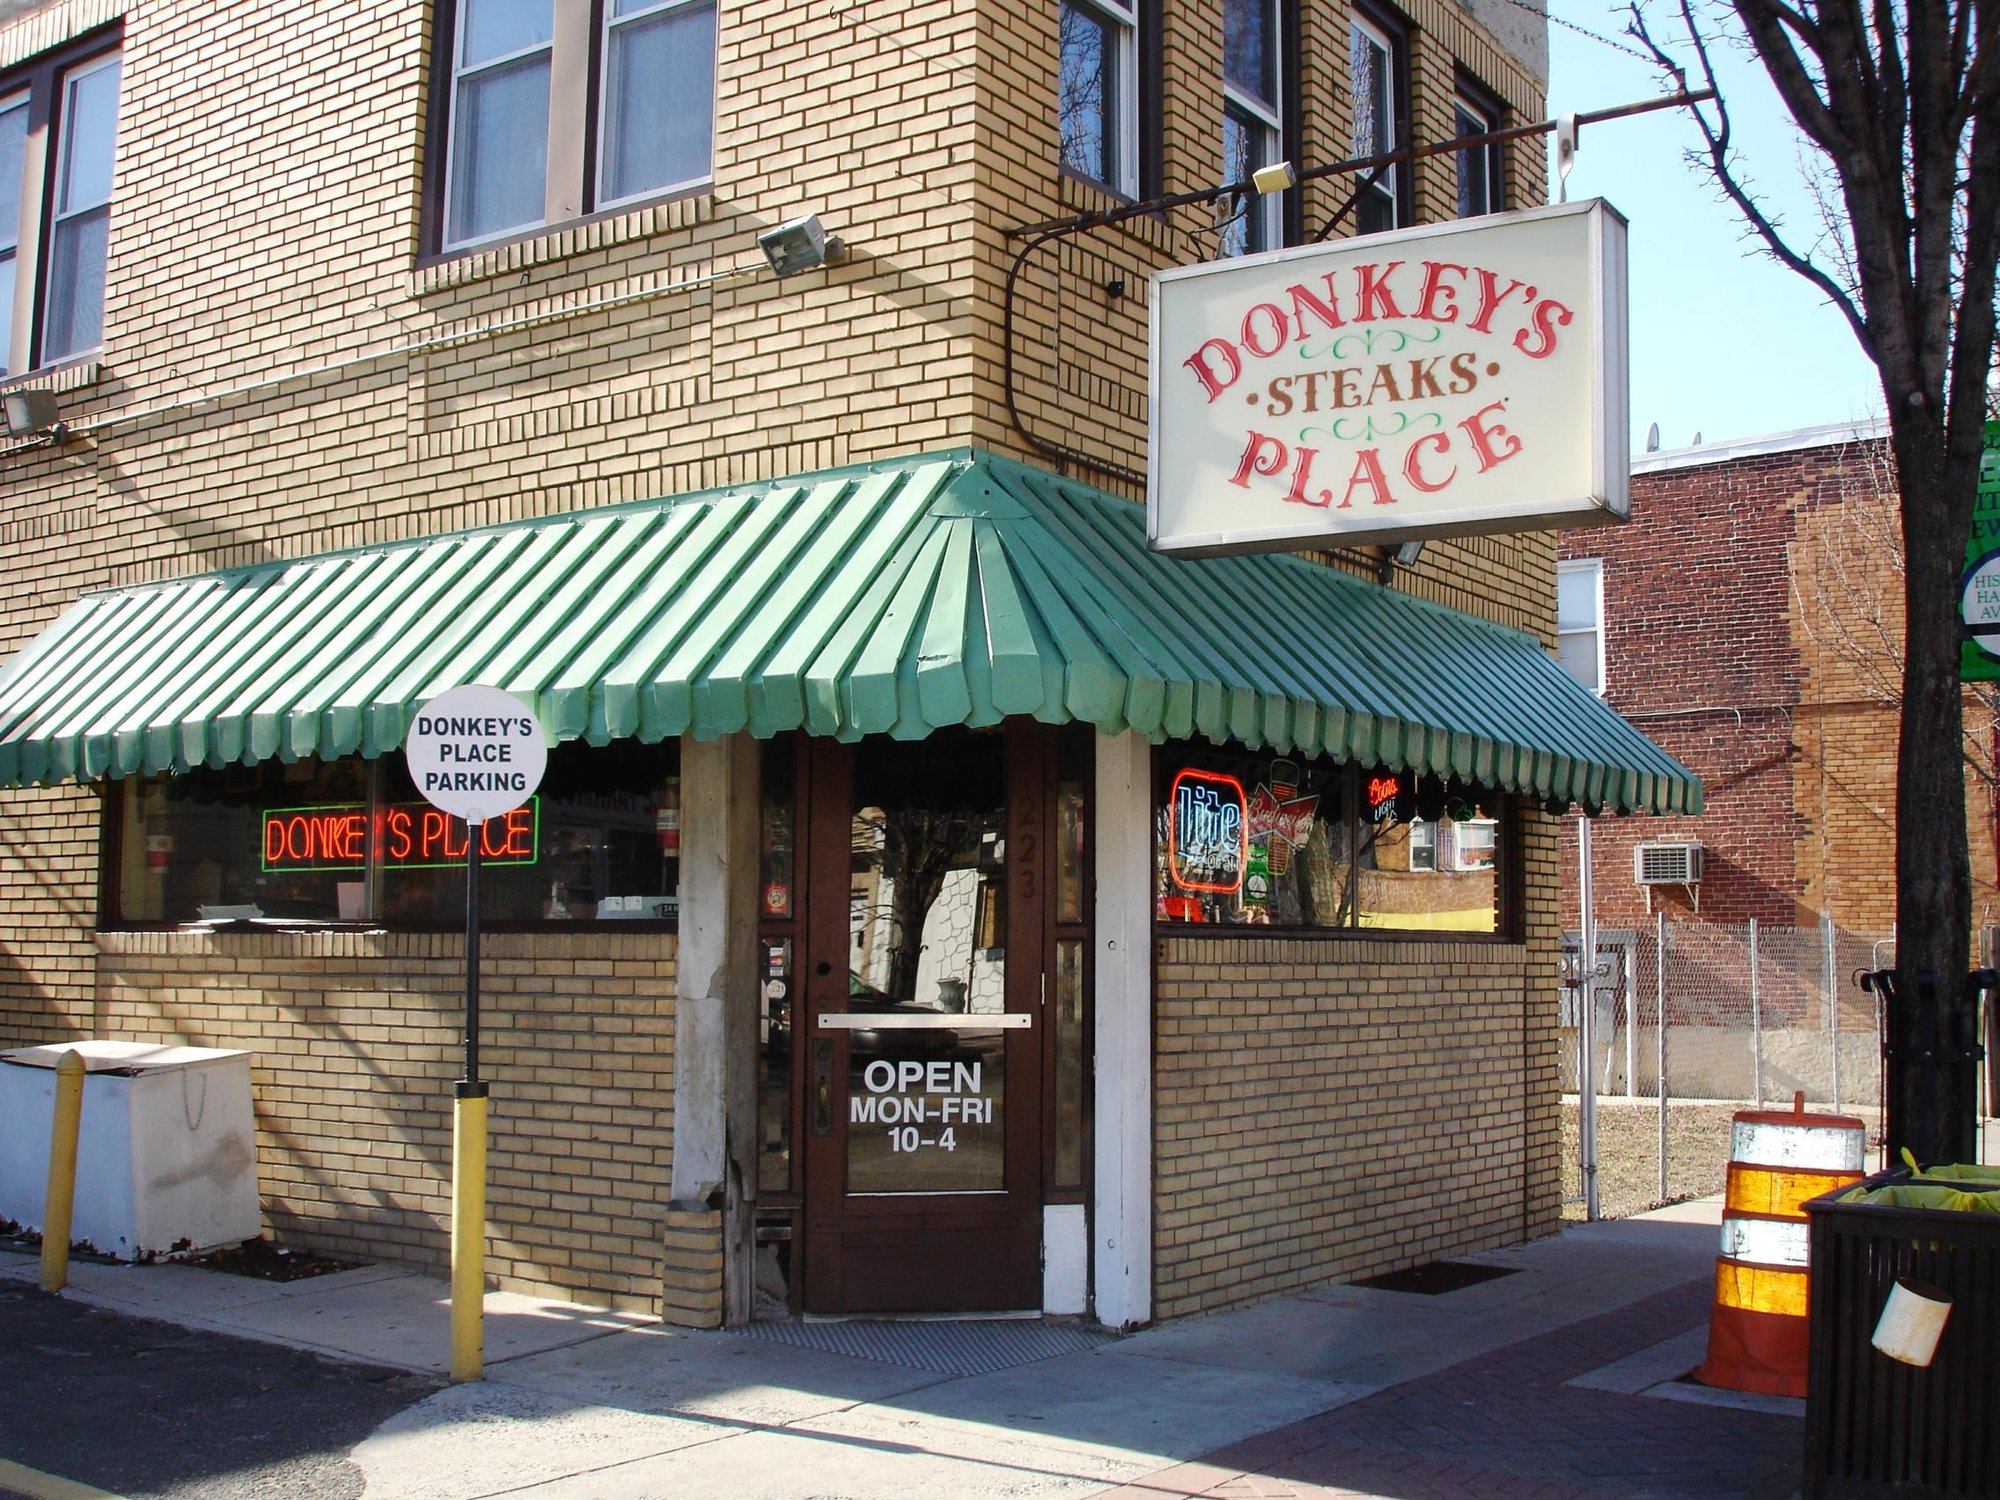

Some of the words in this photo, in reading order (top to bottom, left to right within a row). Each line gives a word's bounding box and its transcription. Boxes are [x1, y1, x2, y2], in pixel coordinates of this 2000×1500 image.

[1182, 260, 1574, 404] DONKEY'S
[1266, 351, 1479, 418] STEAKS
[1228, 400, 1523, 510] PLACE
[418, 716, 533, 737] DONKEY'S
[440, 743, 512, 763] PLACE
[425, 772, 526, 792] PARKING
[266, 808, 412, 861] DONKE'S
[423, 809, 531, 857] PLCE
[864, 1060, 981, 1094] OPEN
[850, 1096, 992, 1124] MON-FRI
[888, 1126, 957, 1153] 10-4
